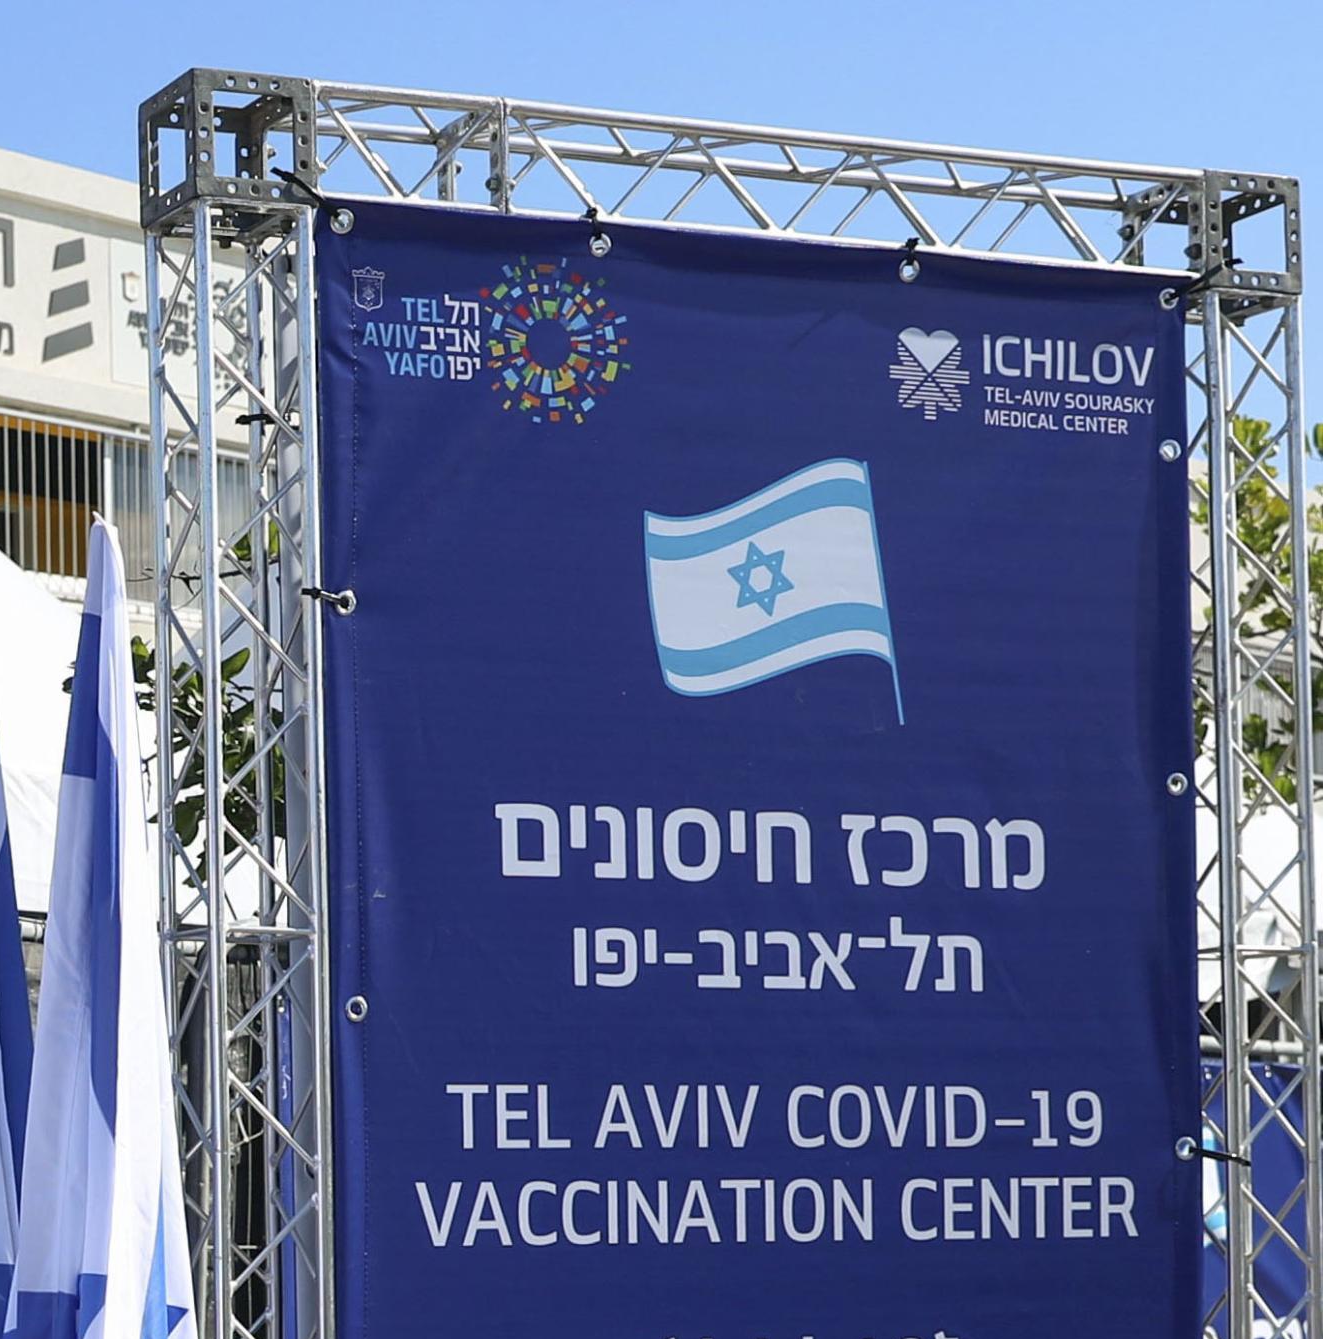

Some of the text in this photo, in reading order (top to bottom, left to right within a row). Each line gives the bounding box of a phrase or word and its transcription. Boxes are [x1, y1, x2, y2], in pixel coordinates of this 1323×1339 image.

[401, 297, 445, 324] TEL
[444, 293, 480, 326] תל
[362, 322, 418, 349] AVIV
[419, 325, 481, 354] אביב
[384, 351, 446, 379] YAFO
[447, 355, 481, 381] יפו
[982, 334, 1155, 387] ICHILOV
[984, 386, 1156, 415] TEL-AVIV SOURASKY
[984, 409, 1129, 436] MEDICAL CENTER
[494, 803, 1046, 891] מרכז חיסונים
[446, 1084, 1103, 1149] TEL AVIV COVID-19
[415, 1177, 1139, 1247] VACCINATION CENTER
